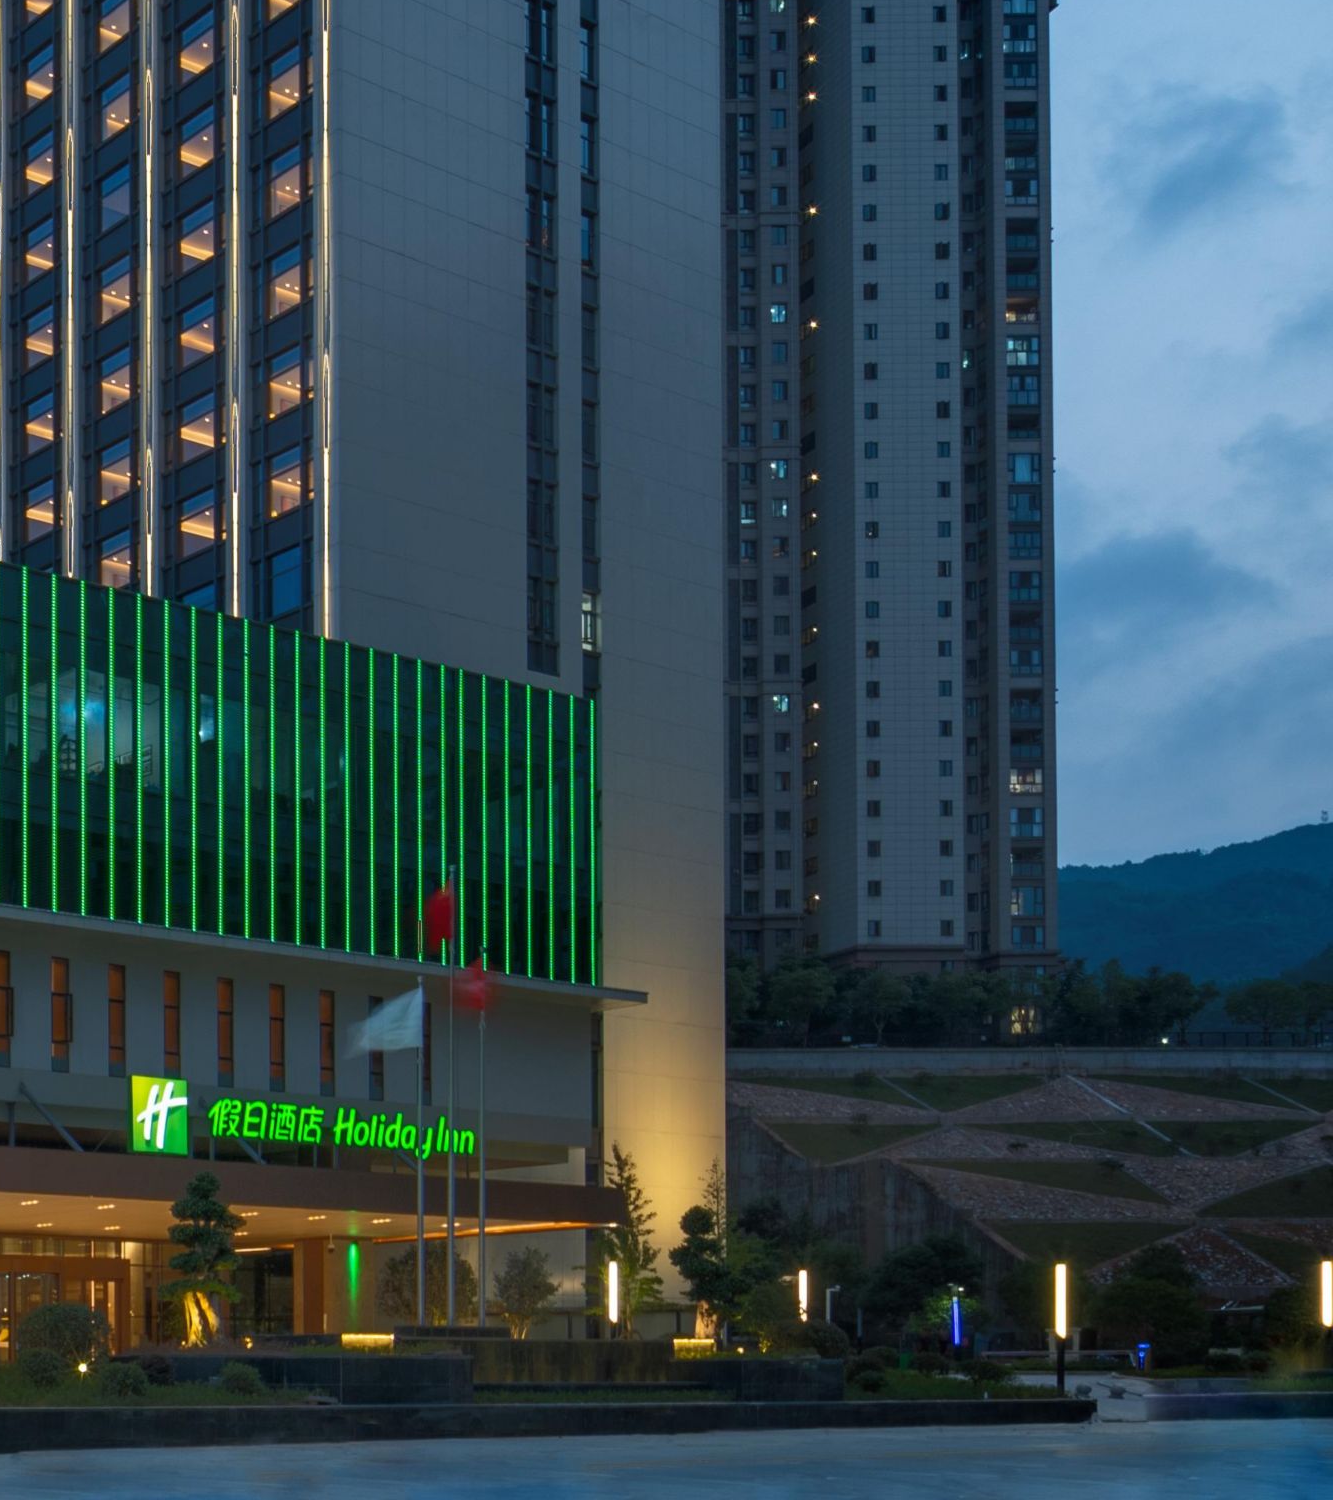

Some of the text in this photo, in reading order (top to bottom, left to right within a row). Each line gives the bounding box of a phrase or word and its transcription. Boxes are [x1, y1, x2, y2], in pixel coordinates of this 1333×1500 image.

[208, 1098, 476, 1161] 假日酒店 Holiday Inn
